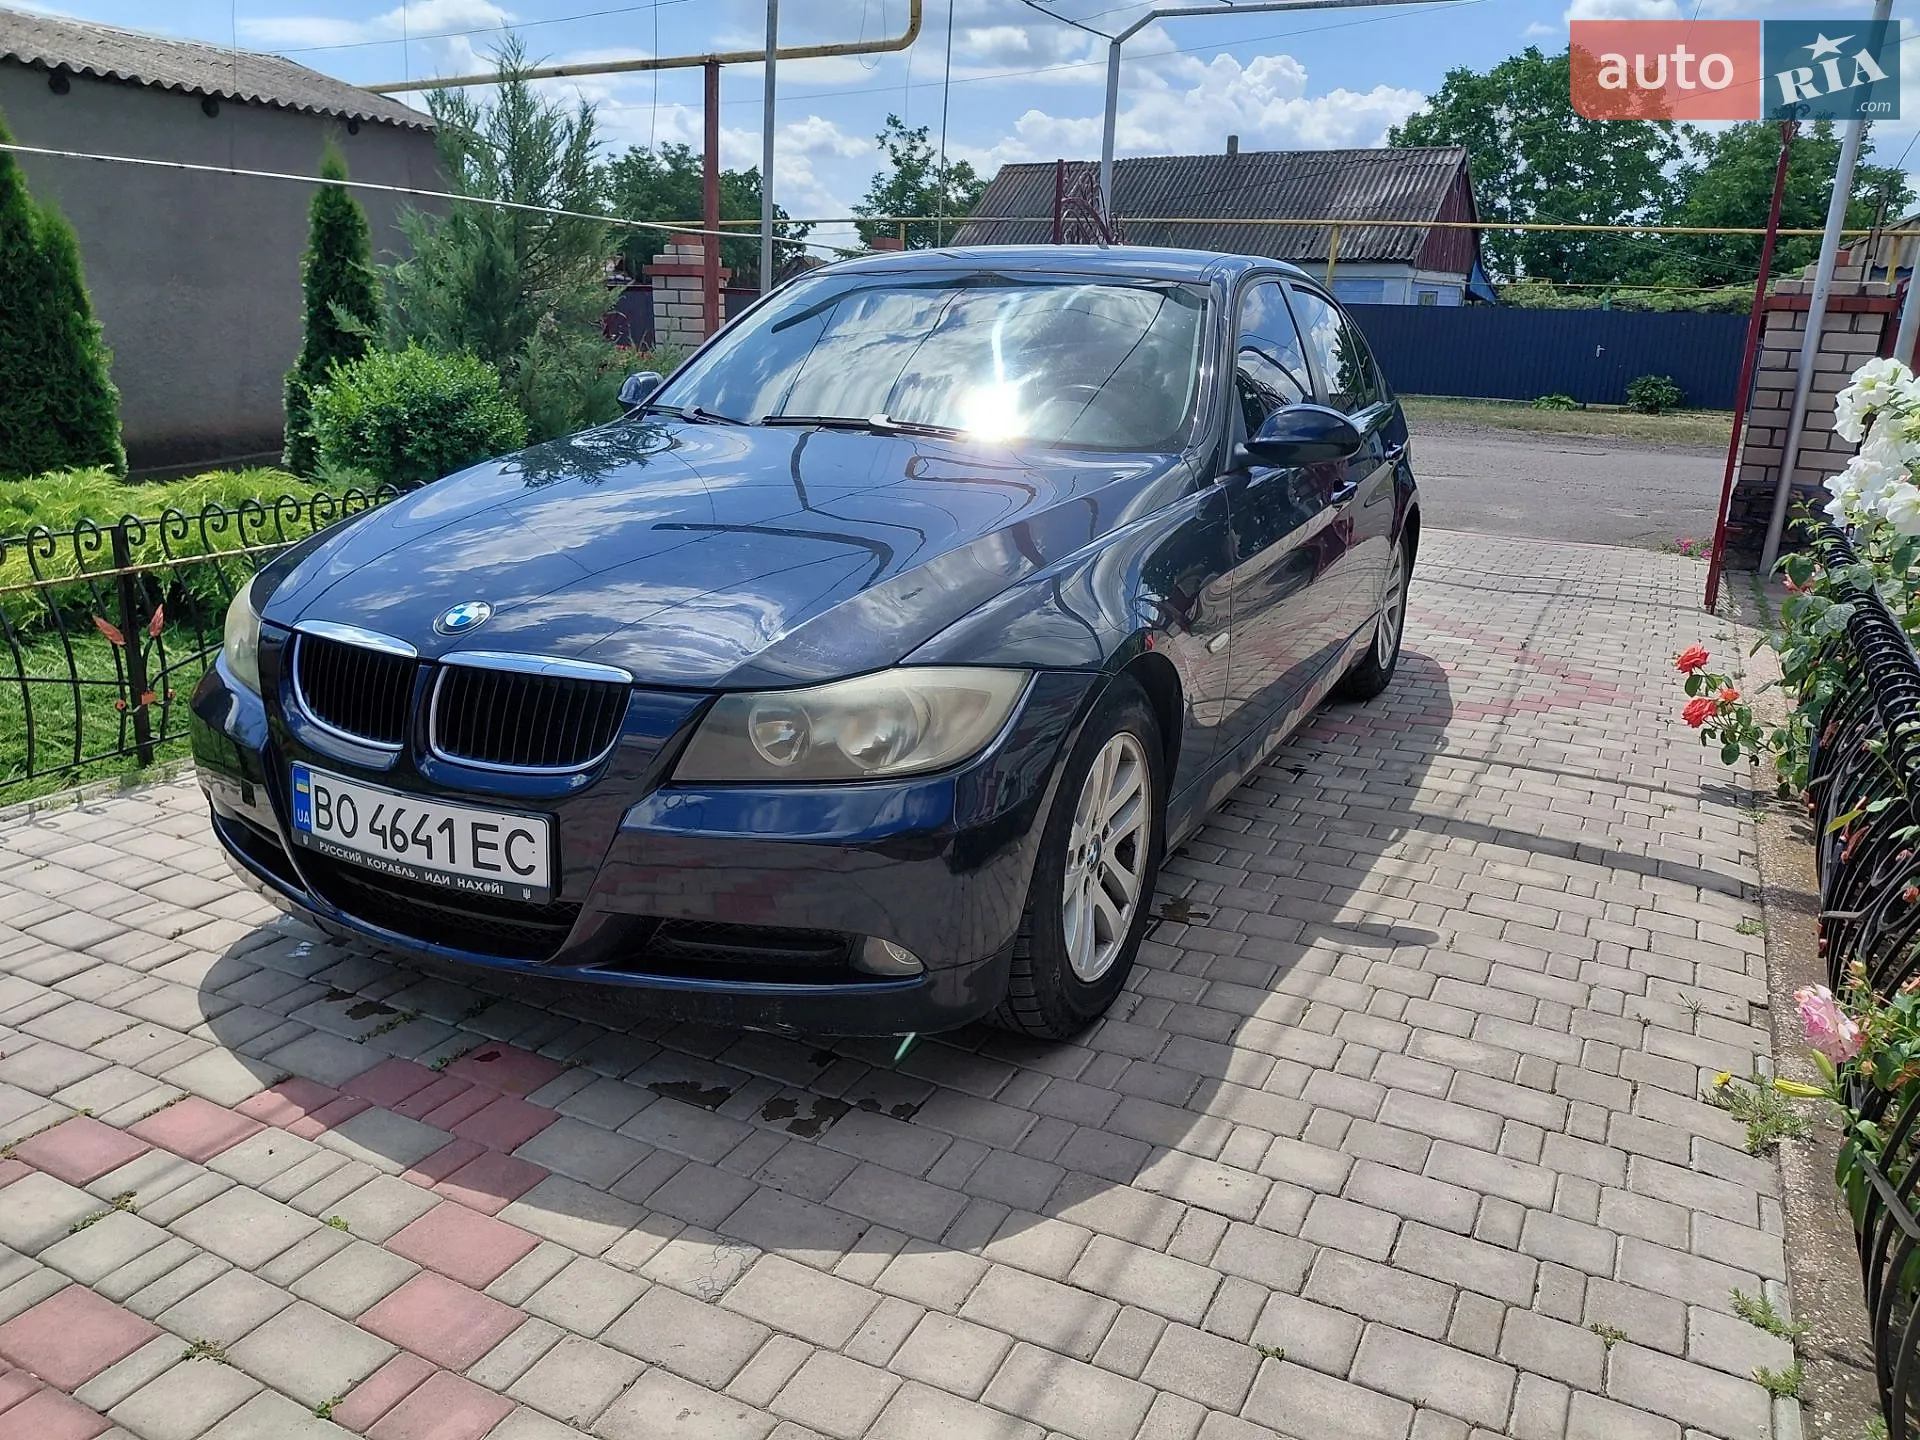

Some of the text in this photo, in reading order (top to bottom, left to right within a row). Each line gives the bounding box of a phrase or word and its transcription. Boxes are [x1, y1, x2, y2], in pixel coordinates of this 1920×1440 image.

[297, 808, 311, 825] UA
[313, 784, 537, 876] BO 4641 EC
[319, 841, 363, 863] РУССКИЙ
[366, 857, 419, 880] КОРАБЛЬ,
[424, 871, 451, 886] ИДИ
